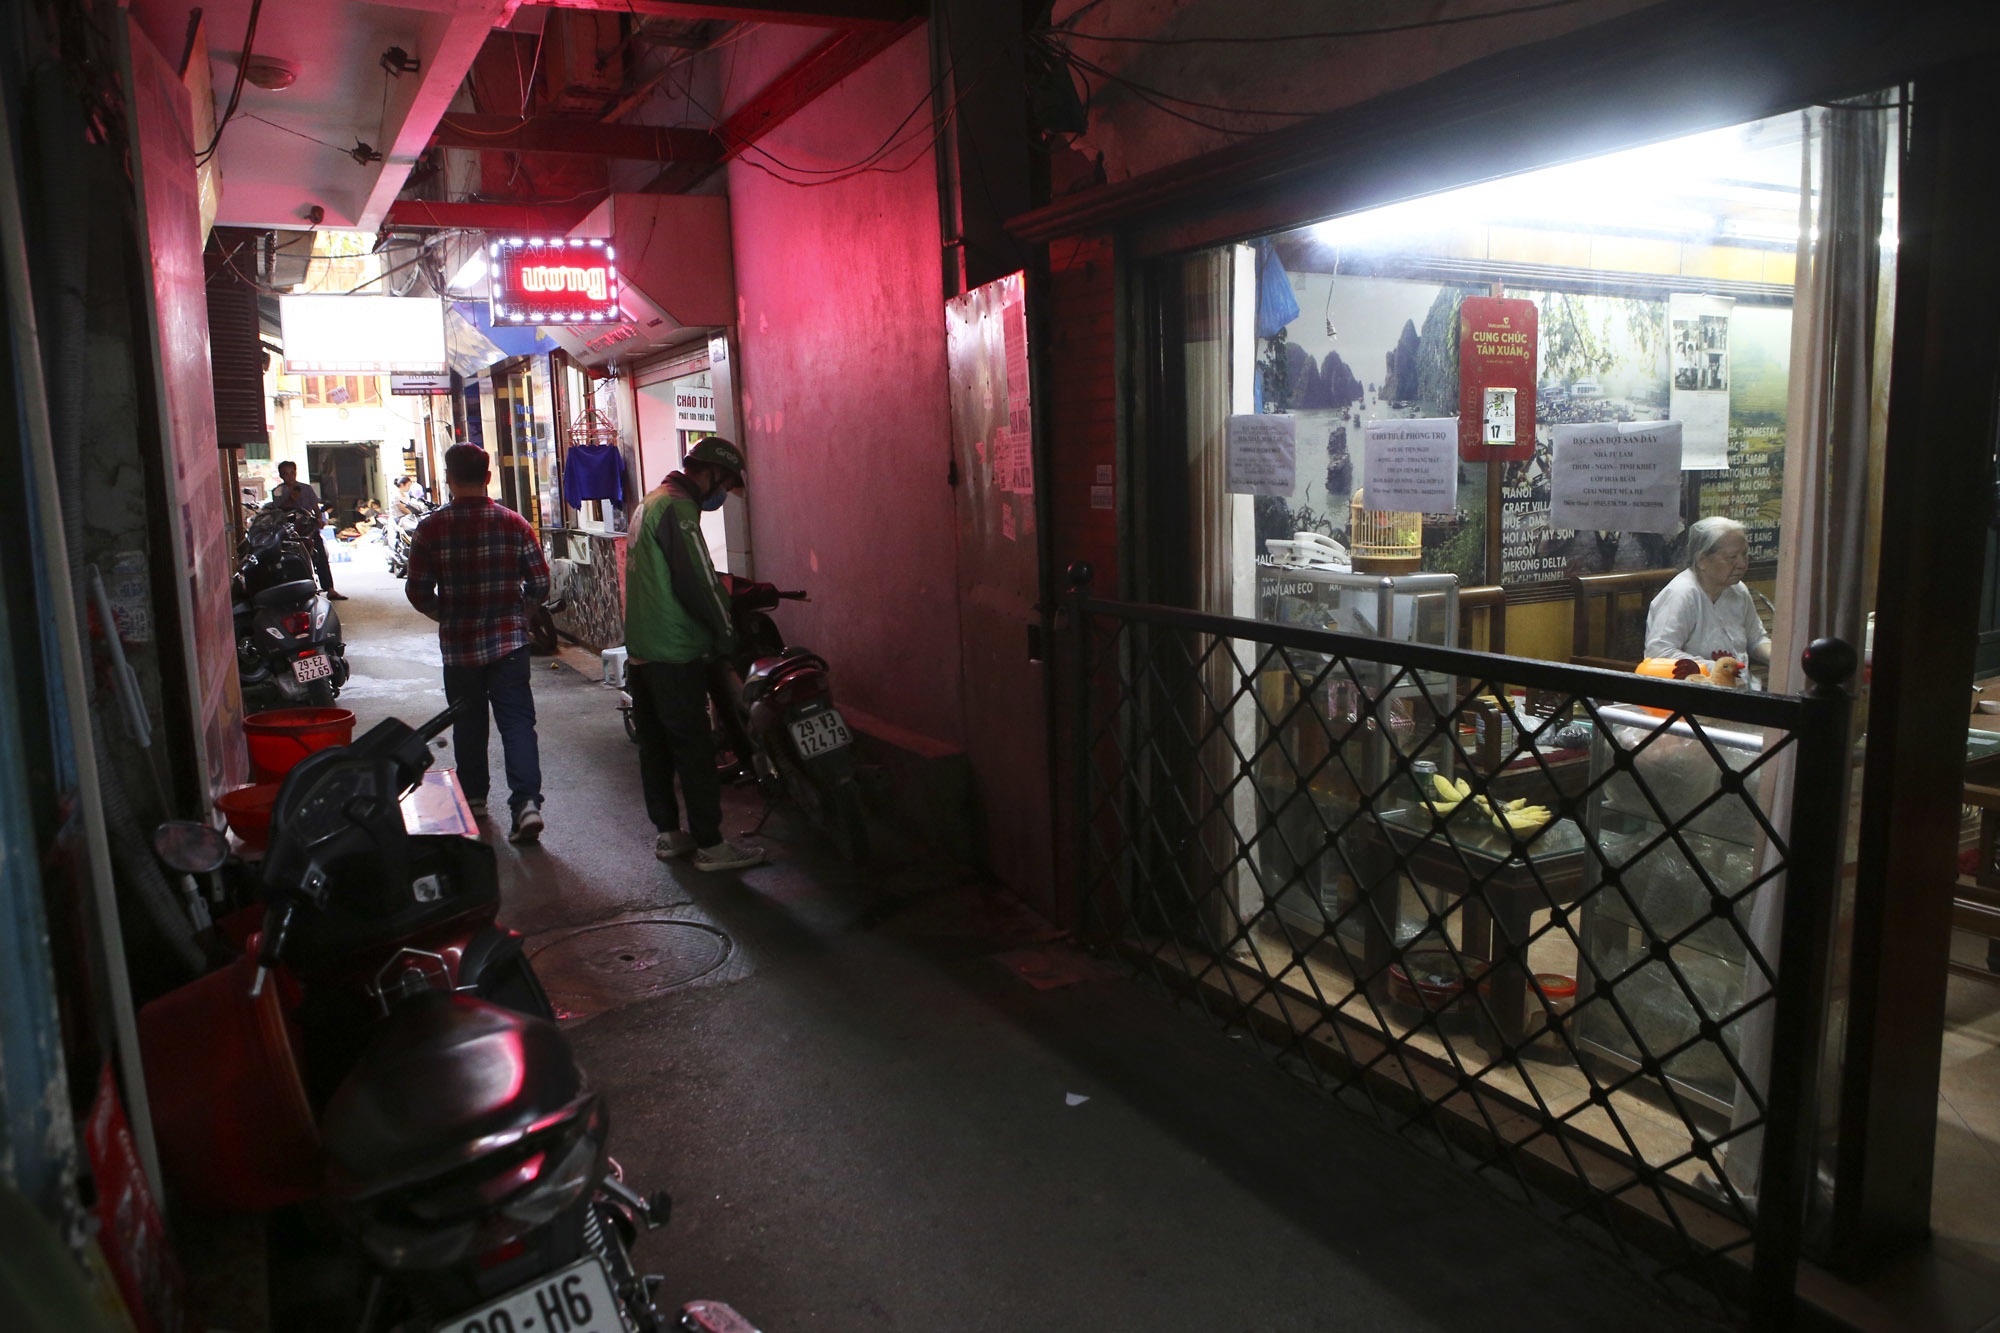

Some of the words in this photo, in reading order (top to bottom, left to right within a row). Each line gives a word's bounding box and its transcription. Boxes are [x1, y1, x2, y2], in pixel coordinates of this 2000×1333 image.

[504, 245, 565, 258] BEAUTY
[1472, 331, 1500, 343] CUNG
[1501, 331, 1528, 344] CHÚC
[1476, 342, 1495, 355] TÂN
[1496, 343, 1523, 357] XUÂN
[1371, 433, 1386, 441] CHO
[1491, 424, 1501, 439] 17
[1743, 426, 1779, 437] HOMESTAY
[715, 447, 739, 464] Grab
[1719, 467, 1752, 479] NATIONAL
[1753, 466, 1771, 476] PARK
[1753, 479, 1772, 490] CHAU
[1503, 487, 1532, 499] HANOI
[1731, 494, 1759, 504] PAGODA
[1503, 501, 1530, 514] CRAFT
[1503, 517, 1521, 530] HUE
[1502, 531, 1519, 544] HOI
[1521, 530, 1534, 542] AN
[1541, 529, 1555, 541] MY
[1556, 529, 1575, 540] SON
[1754, 531, 1773, 542] BANG
[1502, 546, 1536, 559] SAIGON
[1502, 559, 1540, 574] MEKONG
[1542, 557, 1567, 568] DELTA
[1297, 582, 1313, 594] ECO
[298, 656, 324, 671] 29-E2
[298, 664, 330, 682] 522.65
[801, 726, 848, 755] 124.79
